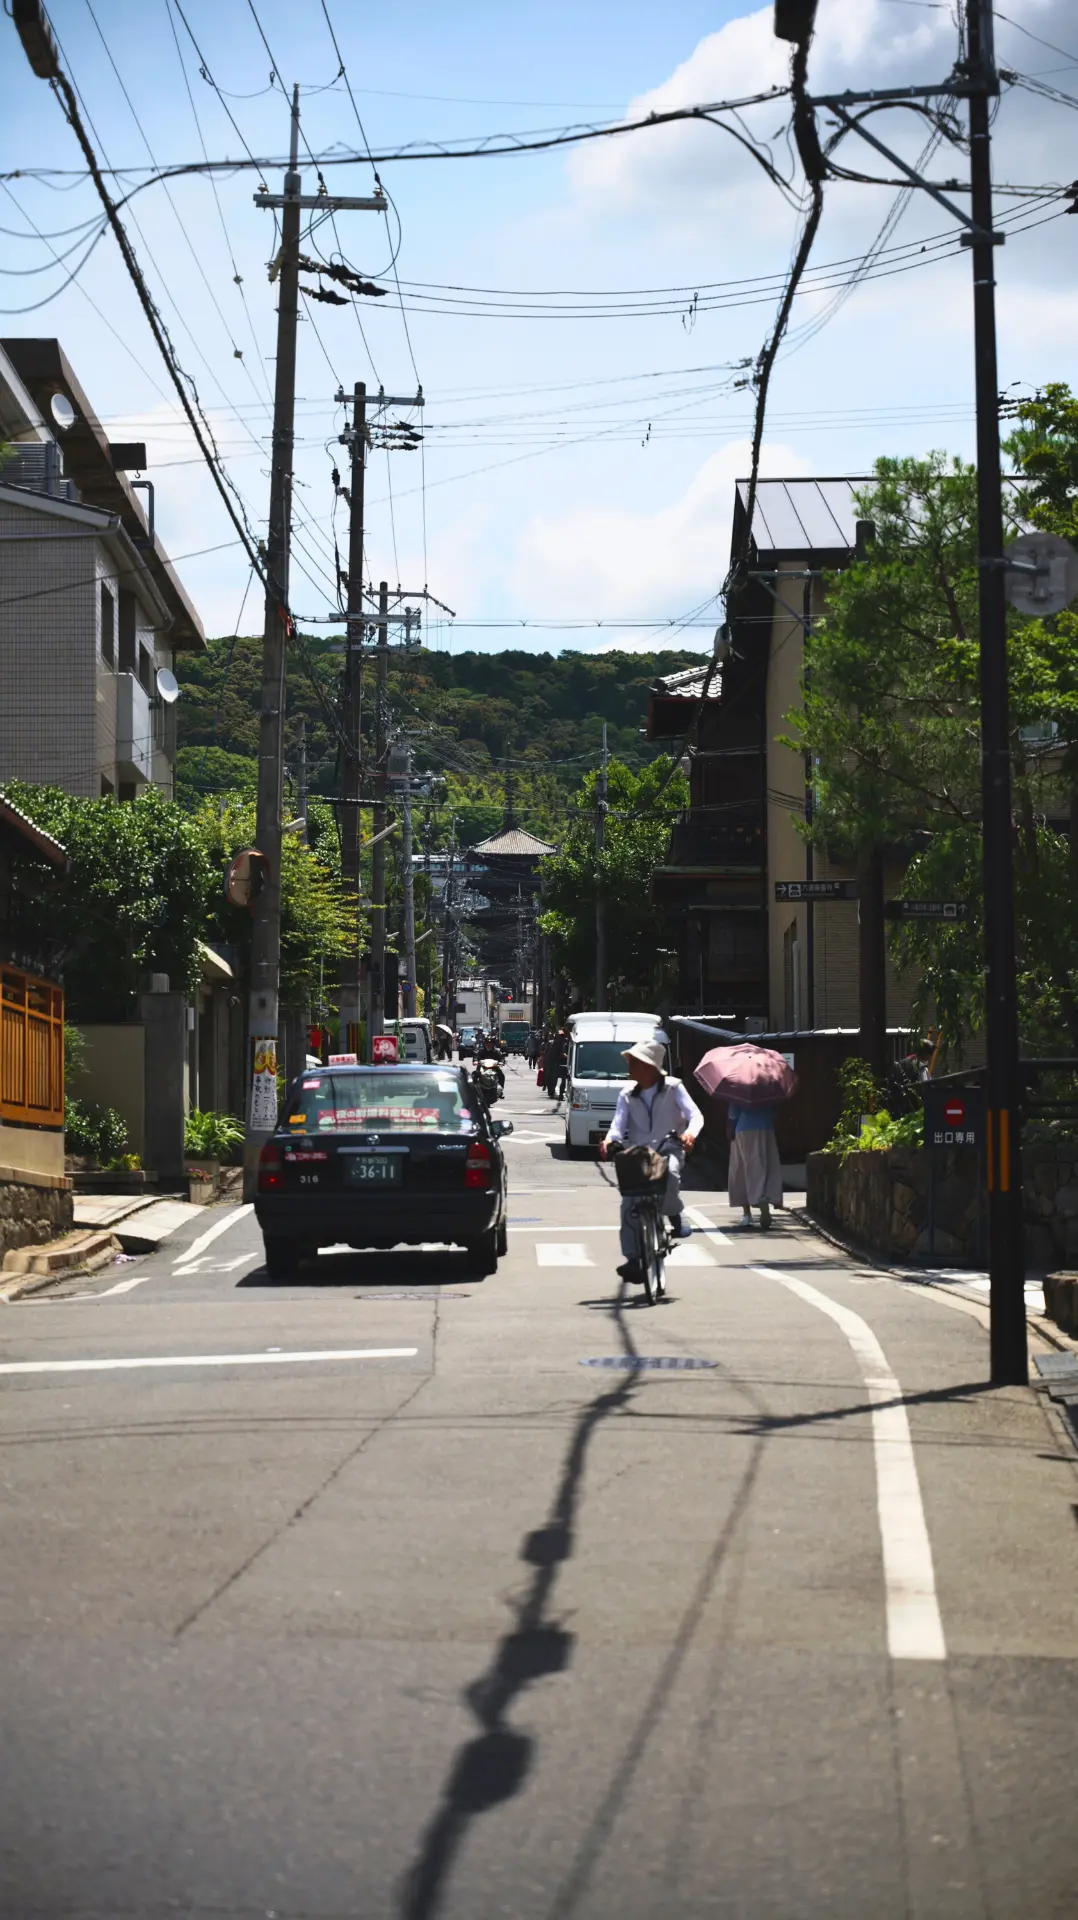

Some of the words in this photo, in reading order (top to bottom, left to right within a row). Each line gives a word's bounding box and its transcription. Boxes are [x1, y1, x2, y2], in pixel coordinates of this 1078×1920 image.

[934, 1131, 975, 1144] 出口専用
[360, 1165, 394, 1179] 36-11
